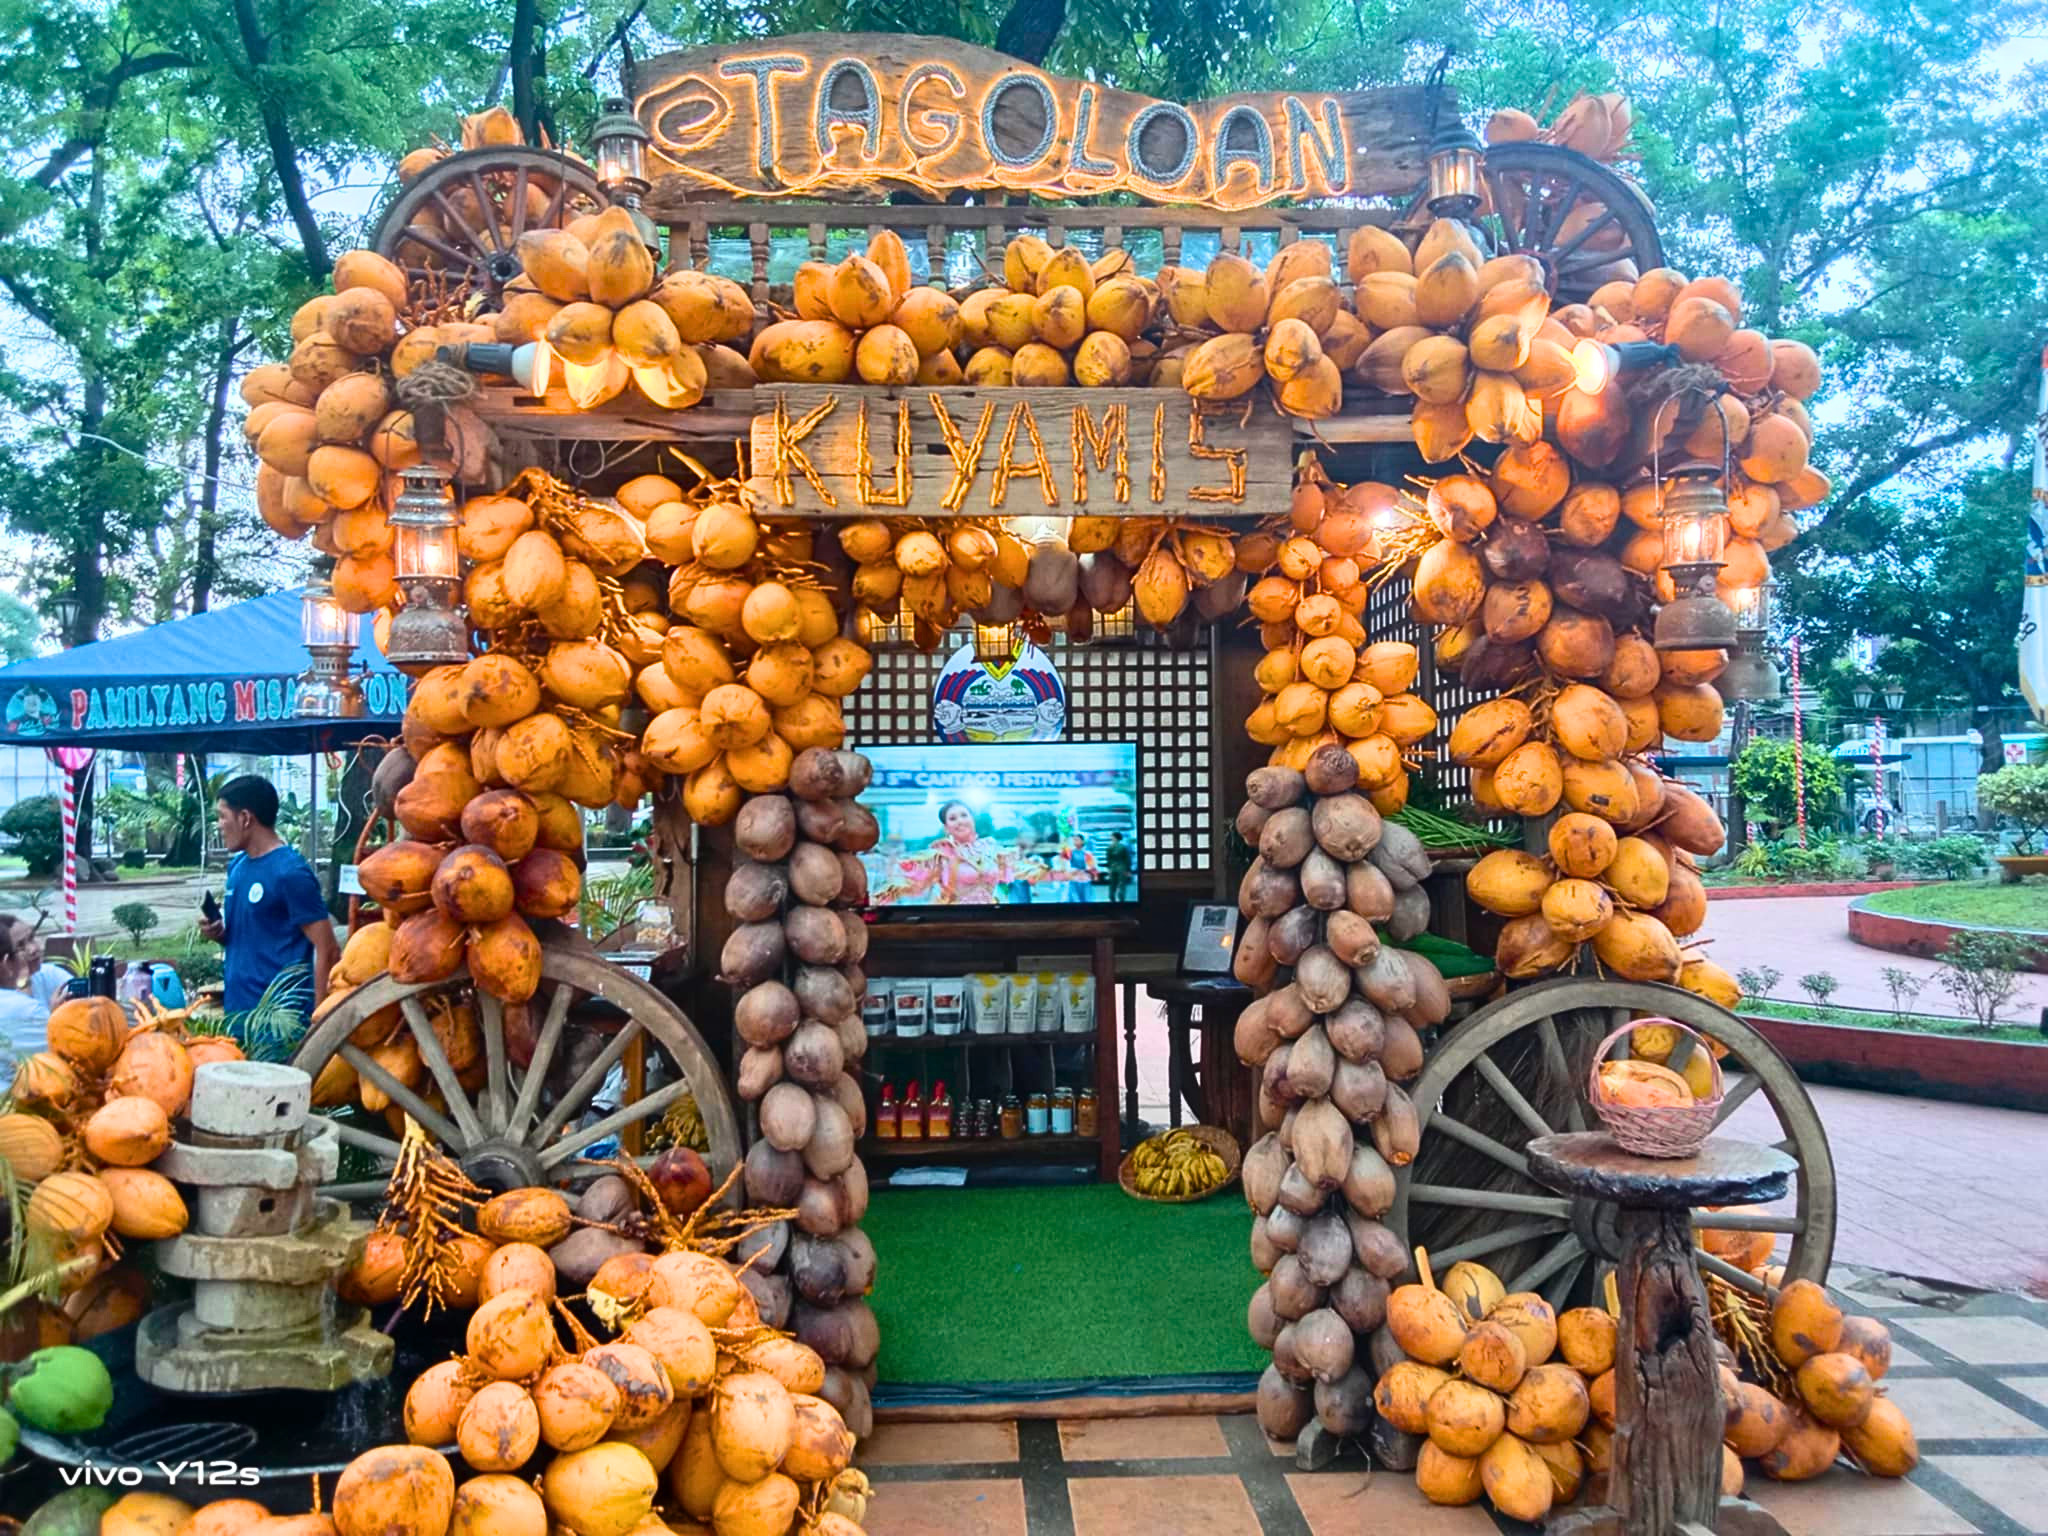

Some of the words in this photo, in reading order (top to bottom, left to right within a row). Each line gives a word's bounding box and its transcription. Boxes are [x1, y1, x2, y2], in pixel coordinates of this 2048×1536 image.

[772, 391, 1248, 511] KUYAMIS
[70, 682, 227, 731] PAMILYANG
[1003, 772, 1080, 786] FESTIVAL
